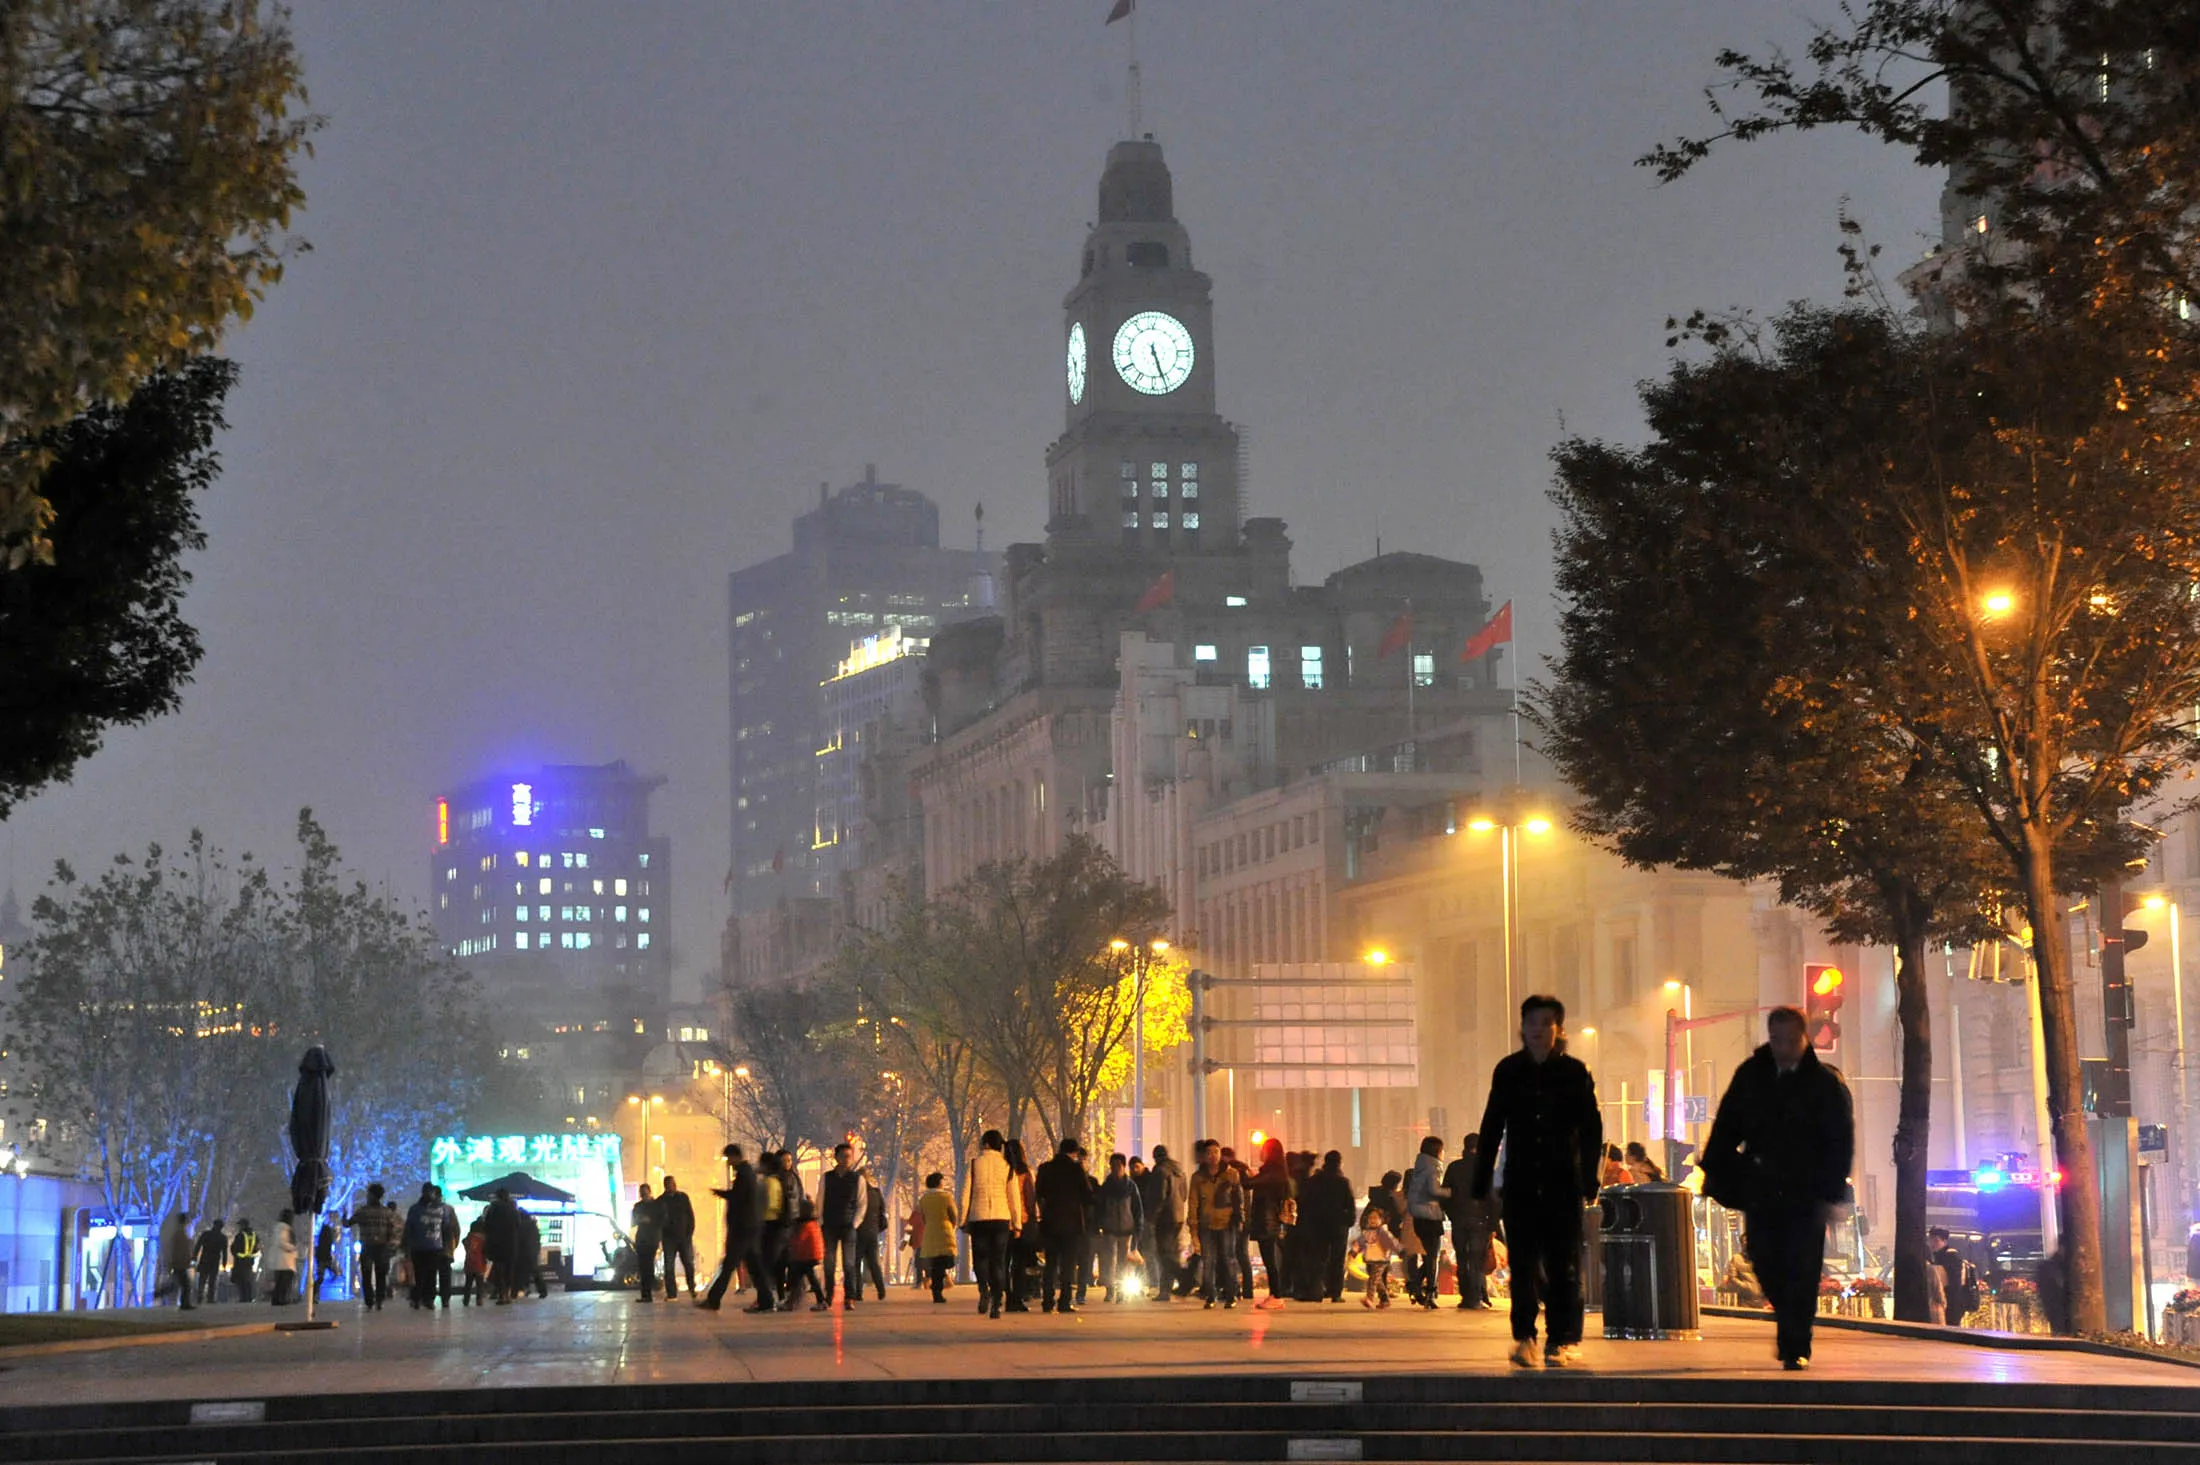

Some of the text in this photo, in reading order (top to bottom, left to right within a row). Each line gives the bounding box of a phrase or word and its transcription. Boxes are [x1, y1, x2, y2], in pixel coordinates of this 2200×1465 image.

[431, 1134, 622, 1165] 外滩观光隧道
